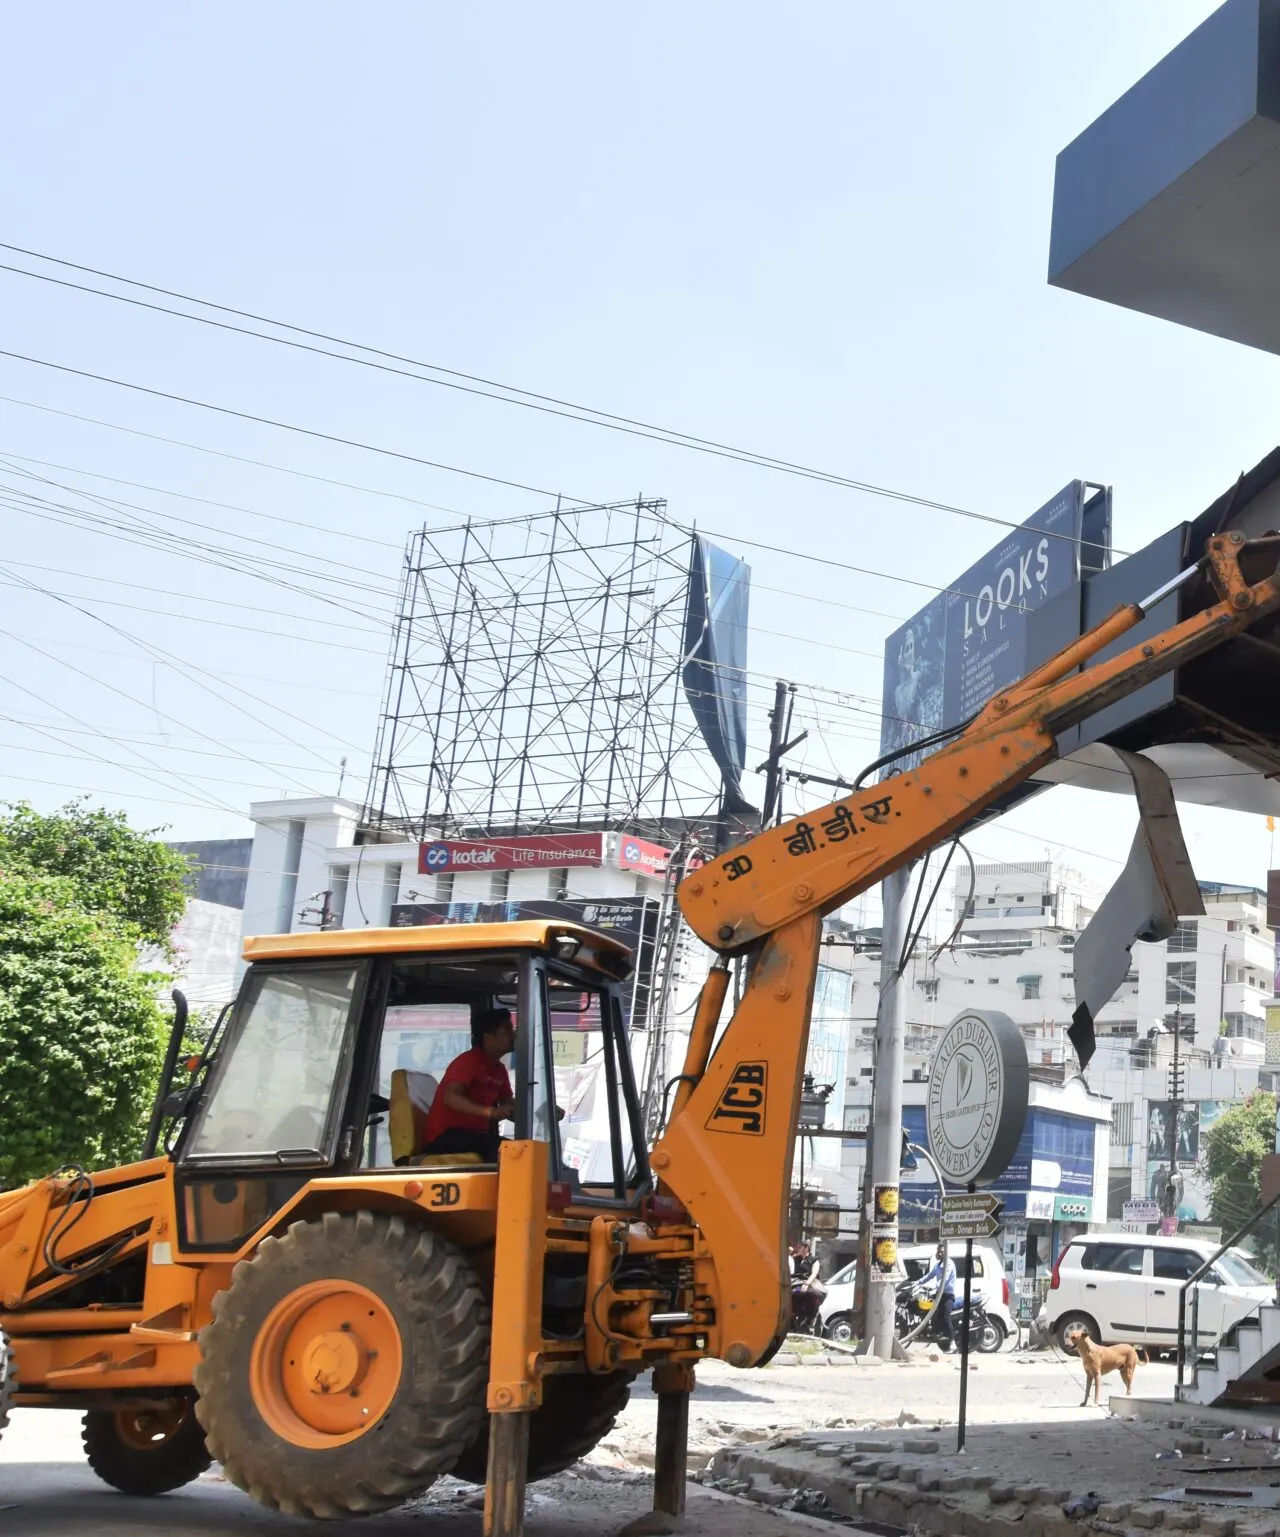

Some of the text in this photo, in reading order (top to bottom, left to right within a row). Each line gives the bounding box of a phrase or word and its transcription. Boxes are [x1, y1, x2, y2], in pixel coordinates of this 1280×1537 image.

[964, 538, 1048, 639] LOOKS
[963, 580, 1047, 657] SALON
[452, 847, 596, 865] kotak Life Insurance
[722, 854, 753, 881] 3D
[940, 1026, 963, 1065] AULD
[965, 1022, 998, 1094] DUBLINER
[713, 1065, 764, 1132] JCB
[932, 1124, 970, 1171] BREWERY
[973, 1142, 981, 1158] &
[431, 1183, 460, 1206] 3D
[1062, 1203, 1087, 1214] oppo
